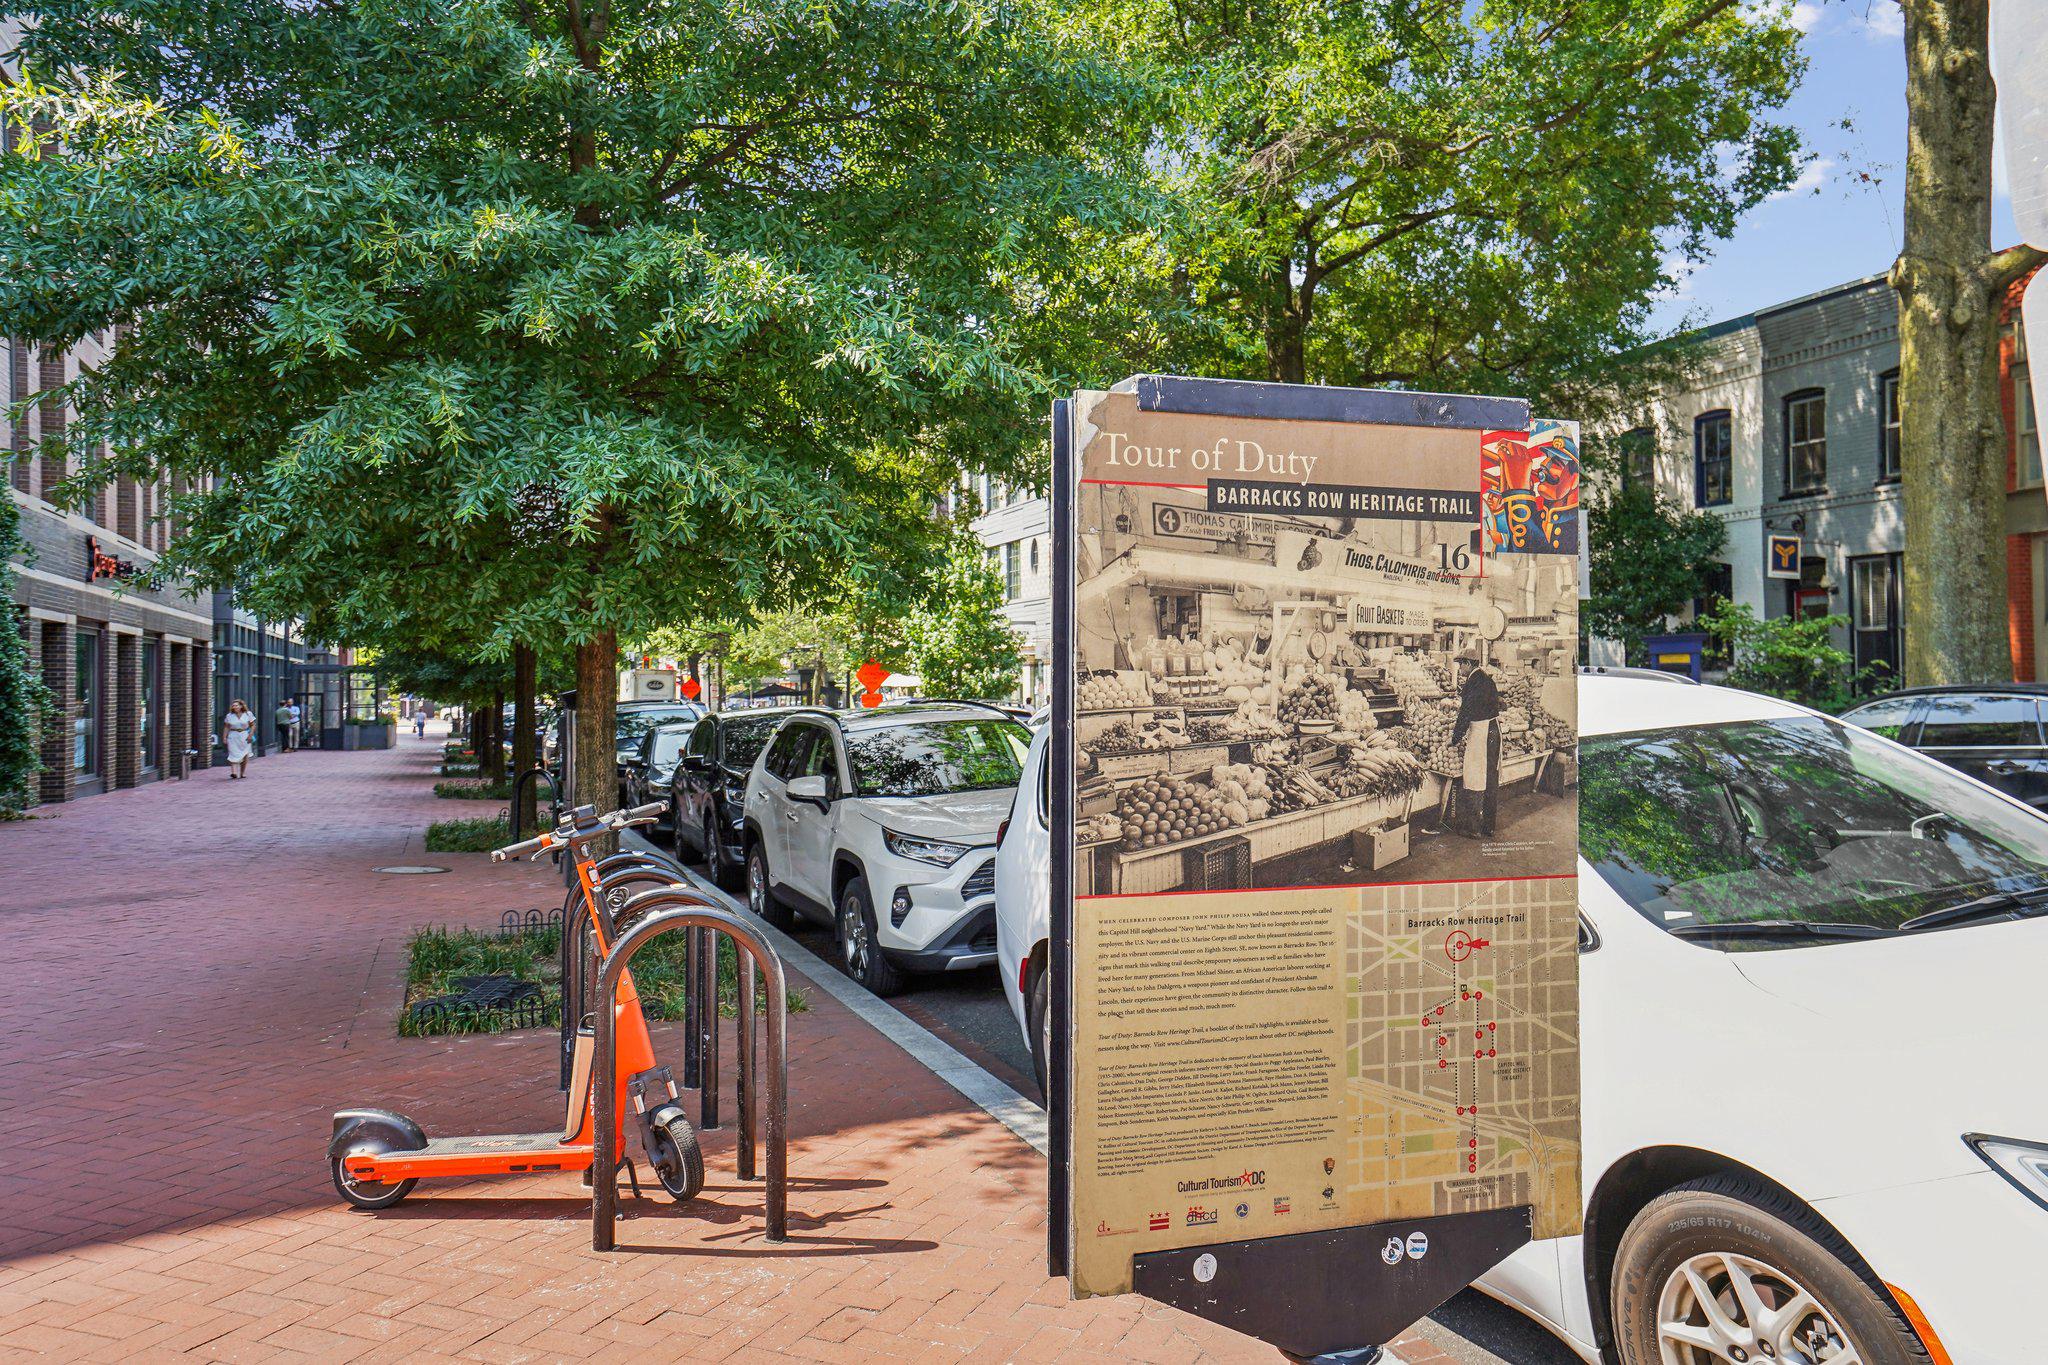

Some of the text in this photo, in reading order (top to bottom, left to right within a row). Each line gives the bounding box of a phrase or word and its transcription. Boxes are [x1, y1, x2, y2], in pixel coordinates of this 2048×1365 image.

[1100, 433, 1317, 485] Tour of Duty
[1217, 486, 1474, 515] BARRACKS ROW HERITAGE TRAIL
[1162, 510, 1176, 530] 4
[1183, 511, 1225, 527] THOMAS
[1345, 548, 1374, 570] THOS.
[1376, 554, 1427, 579] CALOMIRIS
[1427, 570, 1440, 581] and
[1438, 543, 1470, 570] 16
[1356, 604, 1404, 625] FRUIT BASKETS
[1302, 908, 1317, 916] people
[1408, 914, 1525, 928] Barracks Row Heritage Trail
[1110, 929, 1129, 937] Capitol
[1141, 926, 1178, 935] neighborhood
[1205, 947, 1221, 955] Eighth
[1178, 1178, 1208, 1193] Cultural
[1210, 1176, 1241, 1188] Tourism
[1252, 1170, 1265, 1185] DC
[1668, 1217, 1772, 1243] 235/65 R17 104H
